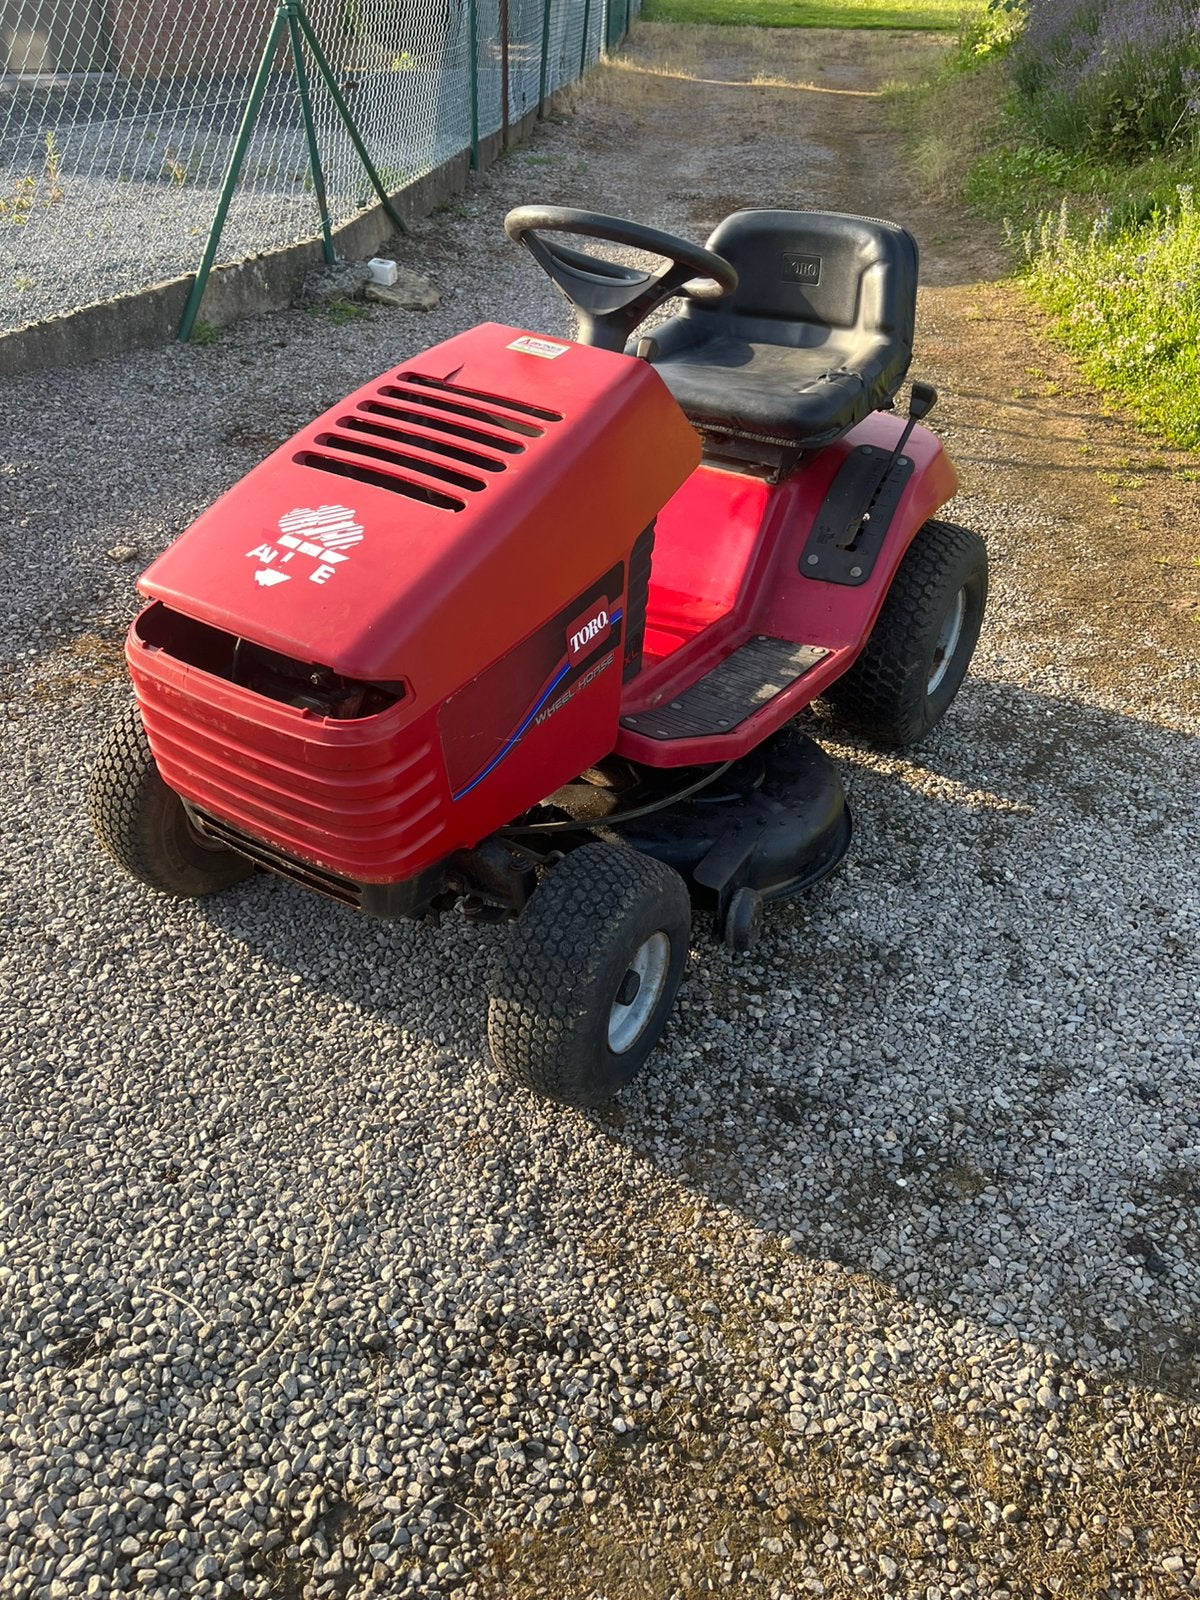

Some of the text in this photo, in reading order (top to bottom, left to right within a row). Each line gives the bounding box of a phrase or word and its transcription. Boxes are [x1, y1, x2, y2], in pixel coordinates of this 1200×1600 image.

[570, 610, 609, 653] TORO
[535, 652, 615, 726] WHEEL HORSE
